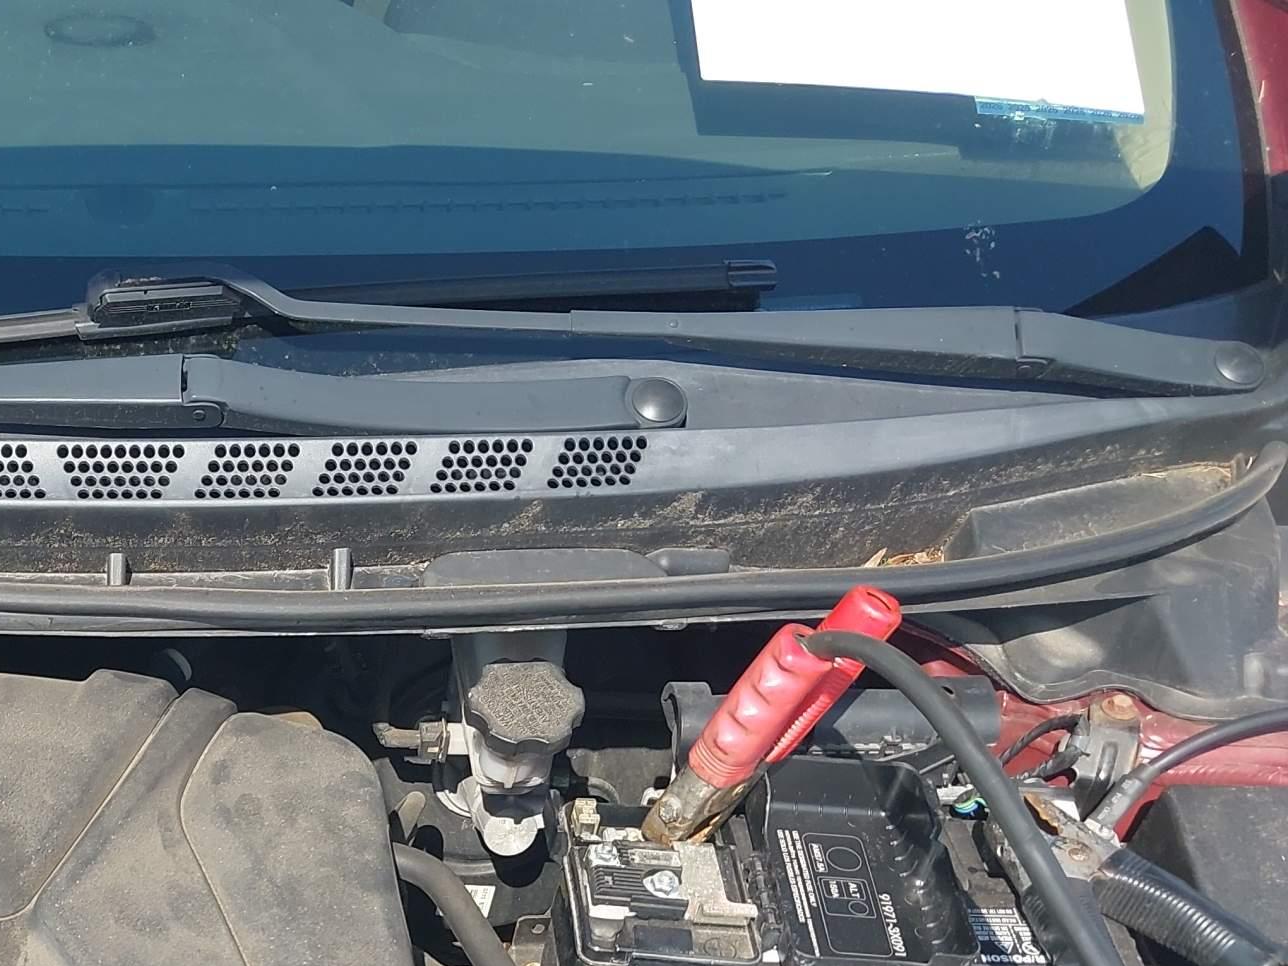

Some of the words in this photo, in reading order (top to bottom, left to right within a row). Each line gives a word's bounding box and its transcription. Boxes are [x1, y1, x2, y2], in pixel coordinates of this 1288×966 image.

[828, 880, 840, 899] 150A
[848, 882, 861, 899] ALT
[879, 893, 906, 957] 91971-3X091
[980, 953, 1046, 964] R/POISON
